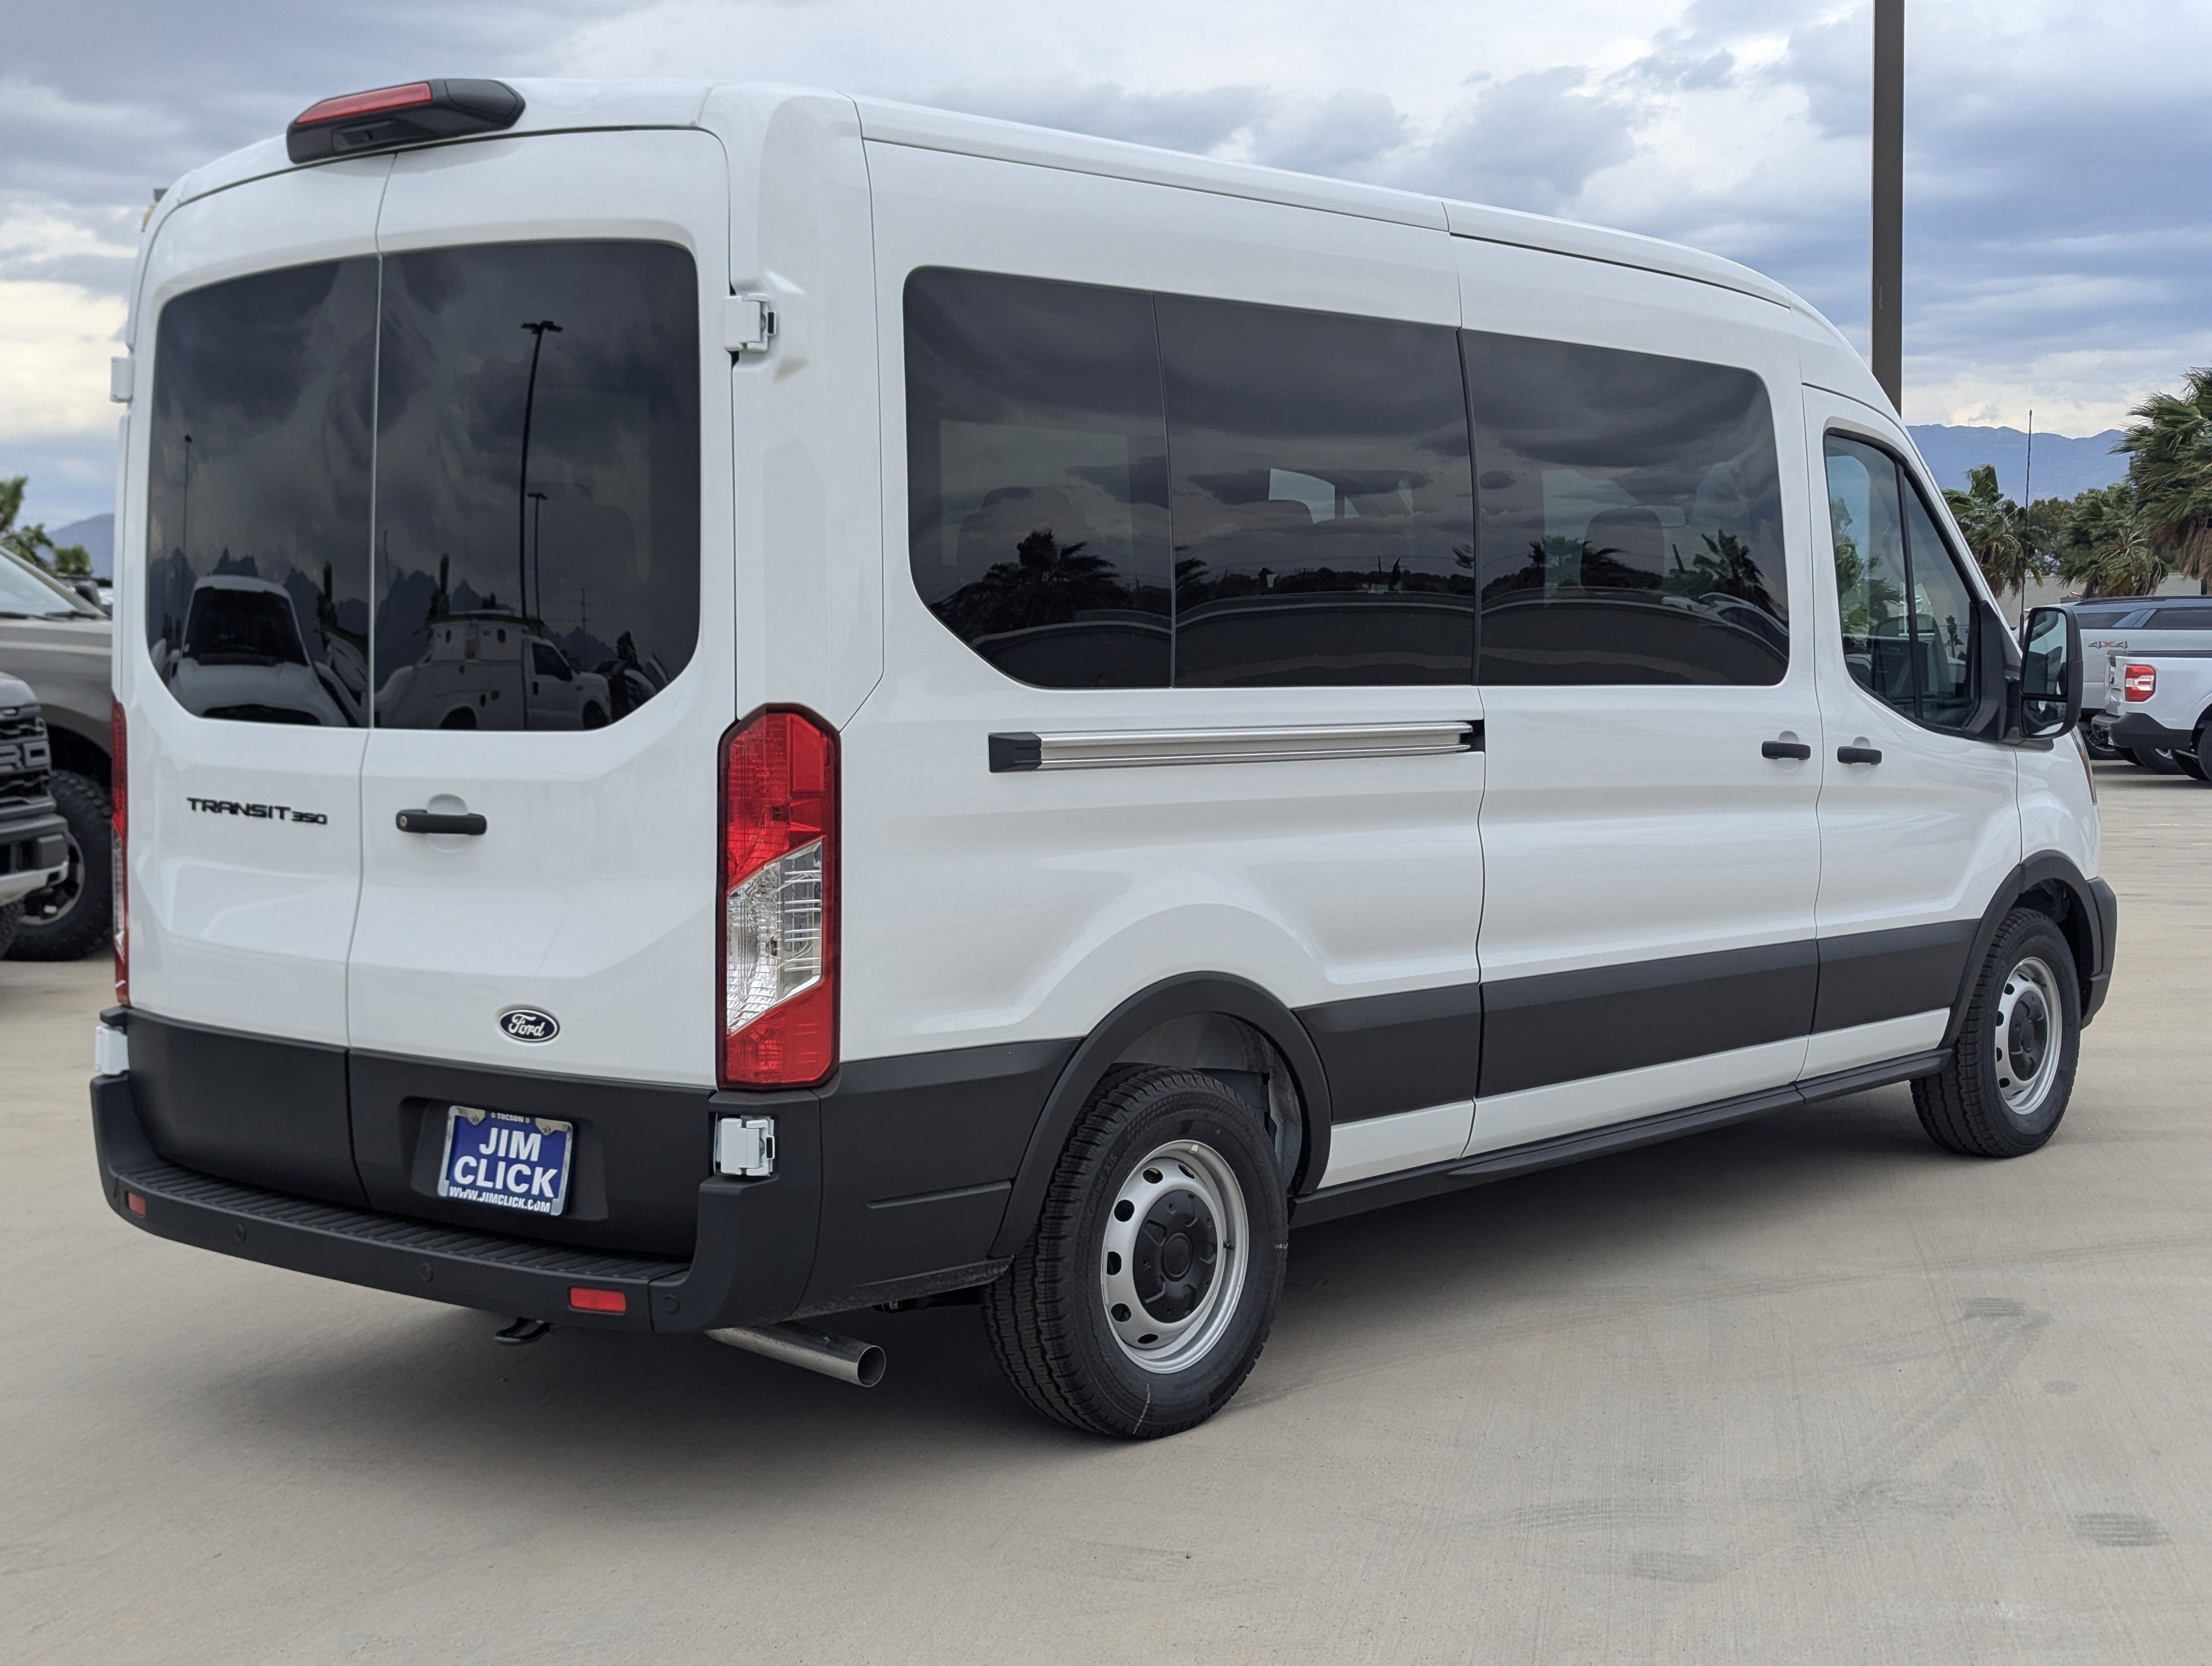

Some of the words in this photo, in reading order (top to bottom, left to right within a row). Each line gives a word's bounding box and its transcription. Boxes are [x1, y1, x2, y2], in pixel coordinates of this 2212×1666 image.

[187, 797, 292, 820] TRANSIT
[291, 811, 328, 825] 350
[507, 1013, 545, 1037] Ford
[496, 1112, 524, 1123] TUCSON
[479, 1127, 542, 1162] JIM
[453, 1155, 558, 1198] CLICK
[449, 1186, 551, 1213] WWW.JIMCLICK.COM
